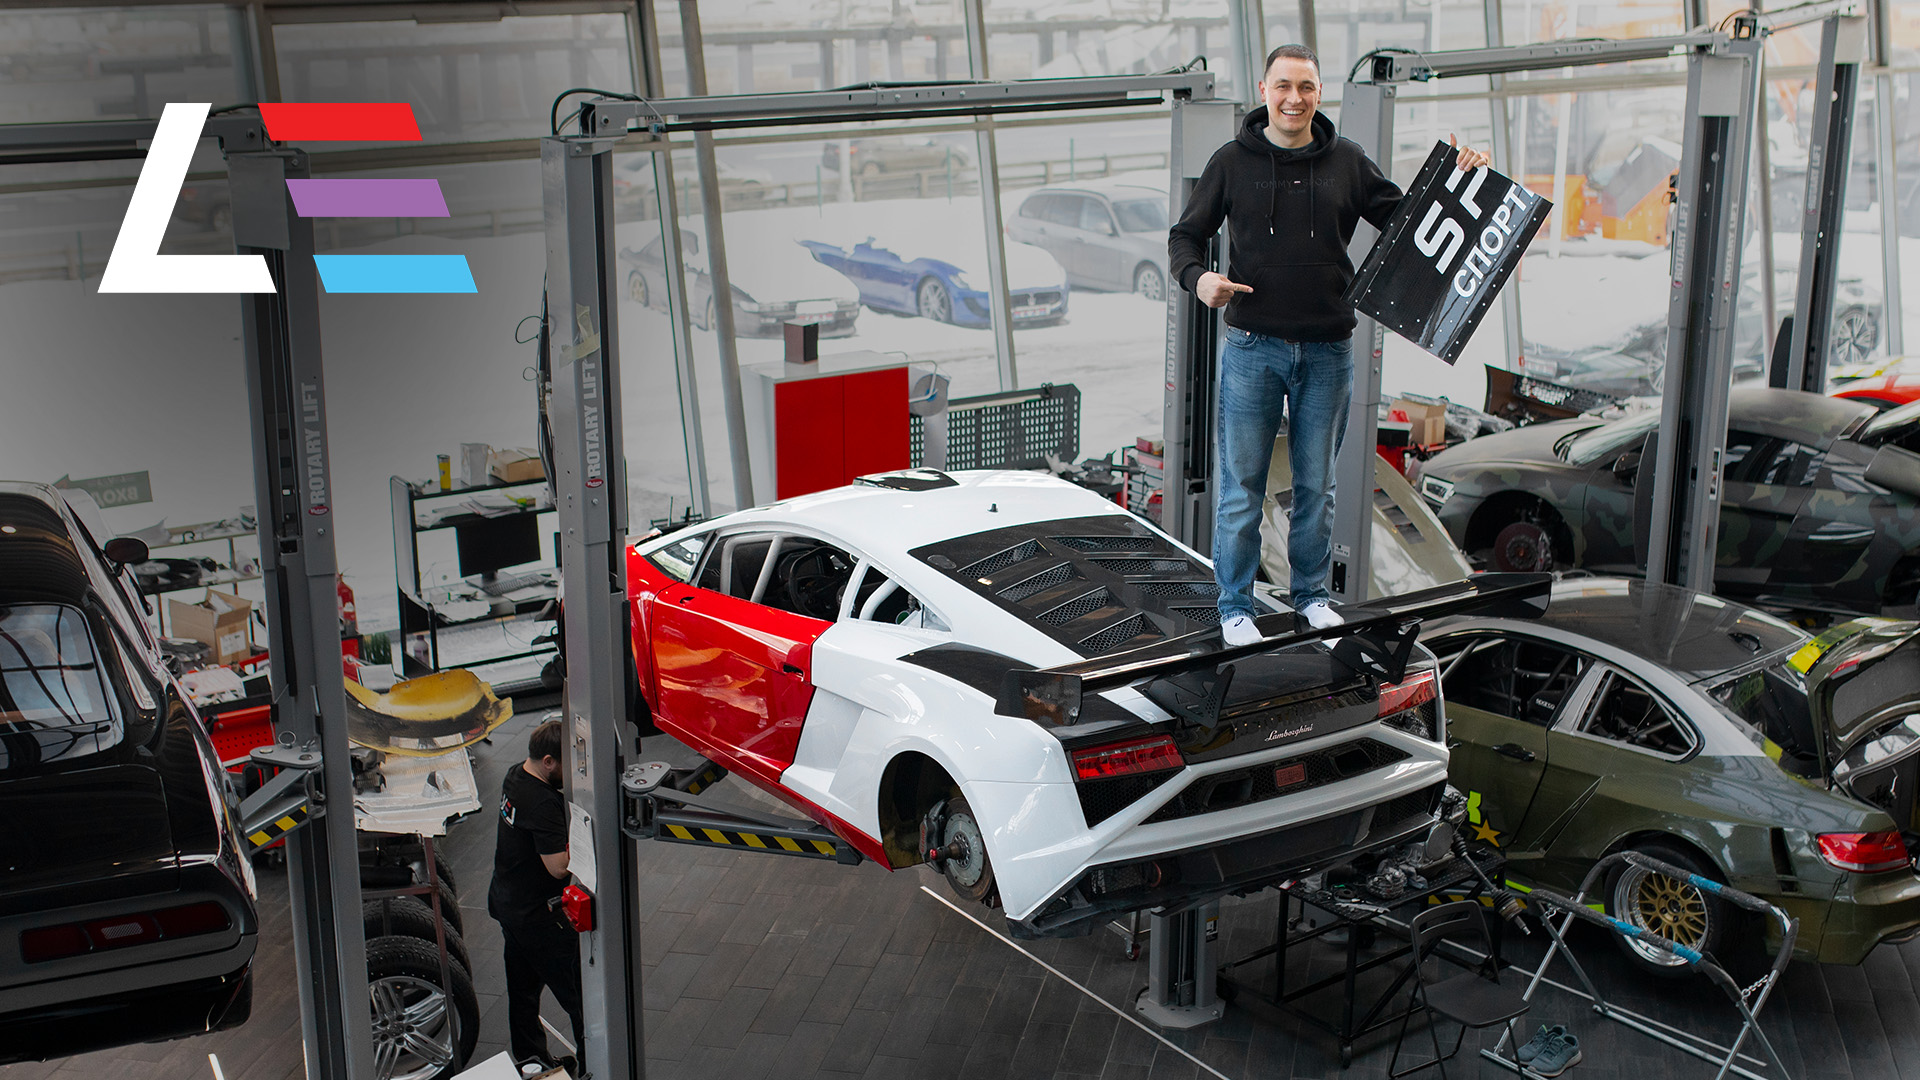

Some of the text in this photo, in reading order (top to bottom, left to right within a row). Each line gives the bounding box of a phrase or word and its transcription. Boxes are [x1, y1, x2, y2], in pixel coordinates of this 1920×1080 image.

[1254, 179, 1293, 190] TOMMY
[1453, 181, 1535, 298] СПОРТ
[1674, 200, 1689, 281] ROTARY LIFT
[1166, 281, 1178, 383] ROTARY LIFT
[301, 382, 320, 422] LIFT
[581, 360, 597, 399] LIFT
[303, 427, 325, 505] ROTARY
[583, 405, 601, 478] ROTARY
[1264, 723, 1314, 742] Lamborghini
